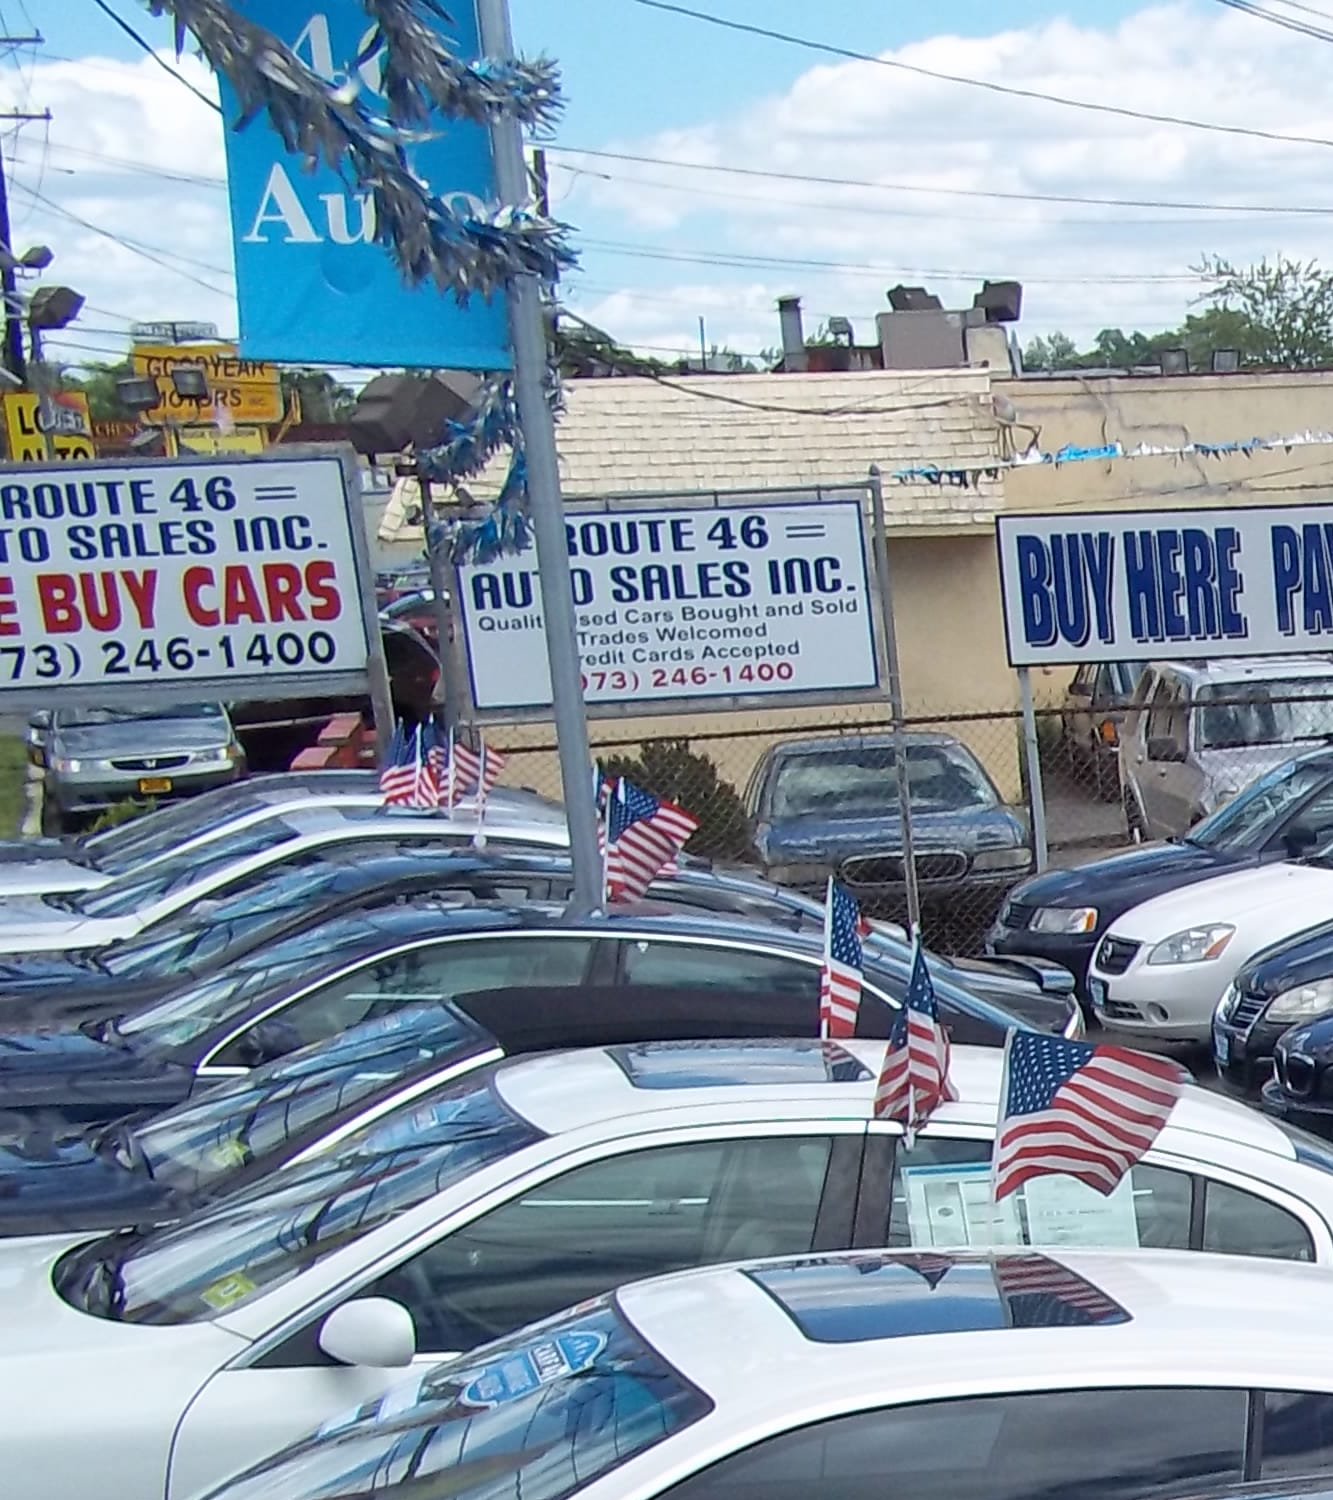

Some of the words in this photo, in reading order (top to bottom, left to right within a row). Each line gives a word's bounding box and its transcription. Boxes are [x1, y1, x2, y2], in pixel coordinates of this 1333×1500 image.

[242, 162, 487, 245] Au
[146, 355, 265, 378] GODYEAR
[170, 476, 237, 513] 46
[67, 519, 217, 561] SALES
[235, 515, 328, 551] INC.
[707, 515, 770, 553] 46
[37, 569, 158, 634] BUY
[182, 560, 342, 628] CARS
[471, 566, 593, 611] AUO
[611, 560, 750, 602] SALES
[768, 556, 857, 595] INC.
[1016, 531, 1115, 647] BUY
[1123, 526, 1248, 641] HERE
[478, 613, 545, 632] Qualit
[573, 609, 618, 629] sed
[625, 608, 674, 626] Cars
[681, 603, 760, 624] Bought
[765, 602, 804, 618] and
[811, 598, 858, 616] Sold
[101, 630, 336, 675] 246-1400
[576, 628, 649, 647] Trades
[655, 623, 767, 643] Welcomed
[577, 645, 625, 666] redit
[632, 645, 695, 664] Cards
[701, 640, 800, 661] Accepted
[581, 669, 640, 692] 73)
[652, 661, 794, 688] 246-1400
